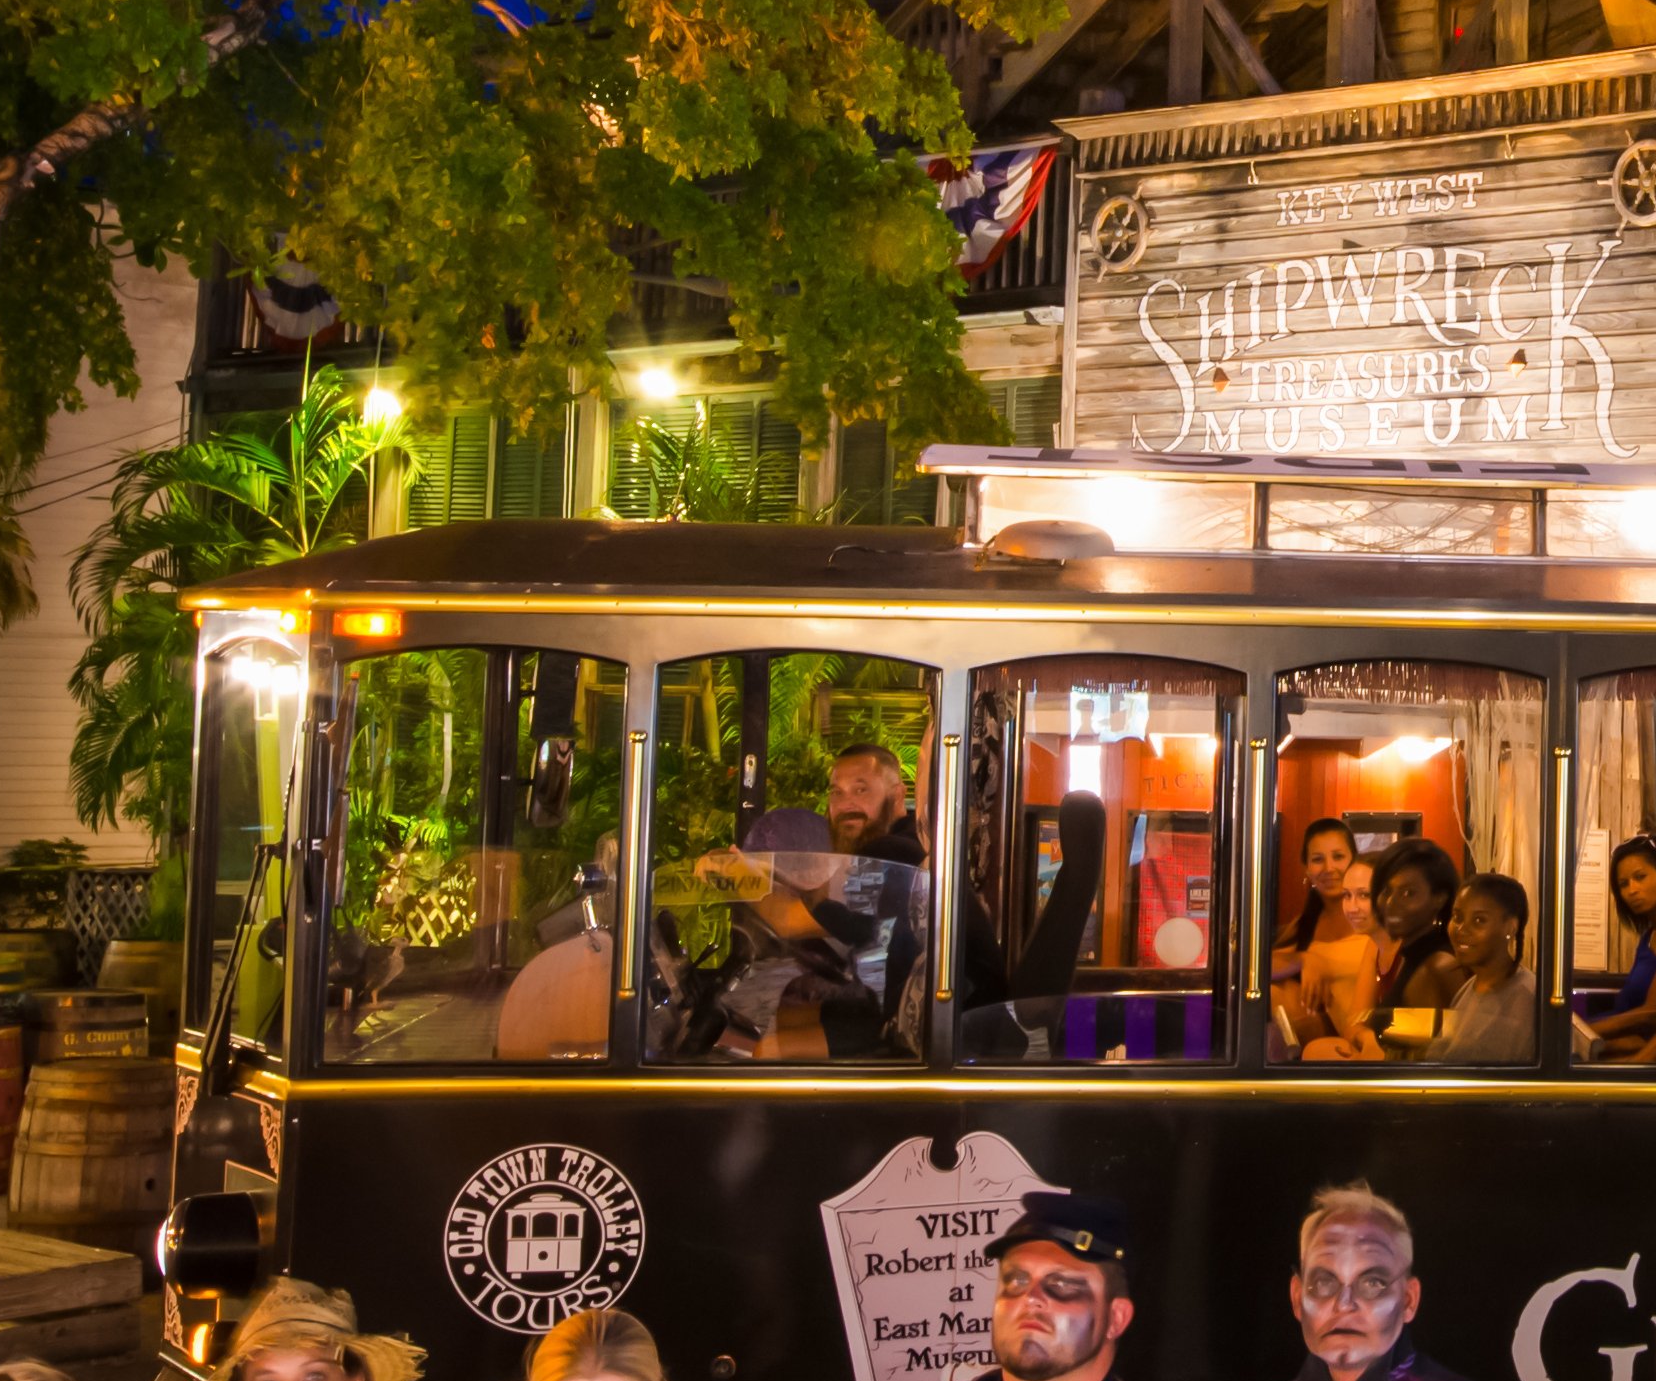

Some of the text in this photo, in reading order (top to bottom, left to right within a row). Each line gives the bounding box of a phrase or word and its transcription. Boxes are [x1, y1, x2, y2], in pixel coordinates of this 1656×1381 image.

[1276, 171, 1484, 227] KEY WEST
[1131, 236, 1640, 458] SHIPWRECK
[1242, 345, 1493, 403] TREASURES
[1203, 394, 1536, 455] MUSEUM
[1144, 773, 1206, 793] TICK
[448, 1148, 639, 1260] OLD TOWN TROLLEY
[915, 1210, 1000, 1241] VISIT
[864, 1250, 995, 1277] Robert the
[468, 1272, 614, 1332] TOURS
[948, 1282, 975, 1303] at
[873, 1308, 992, 1343] East Mar
[905, 1349, 999, 1373] Museu
